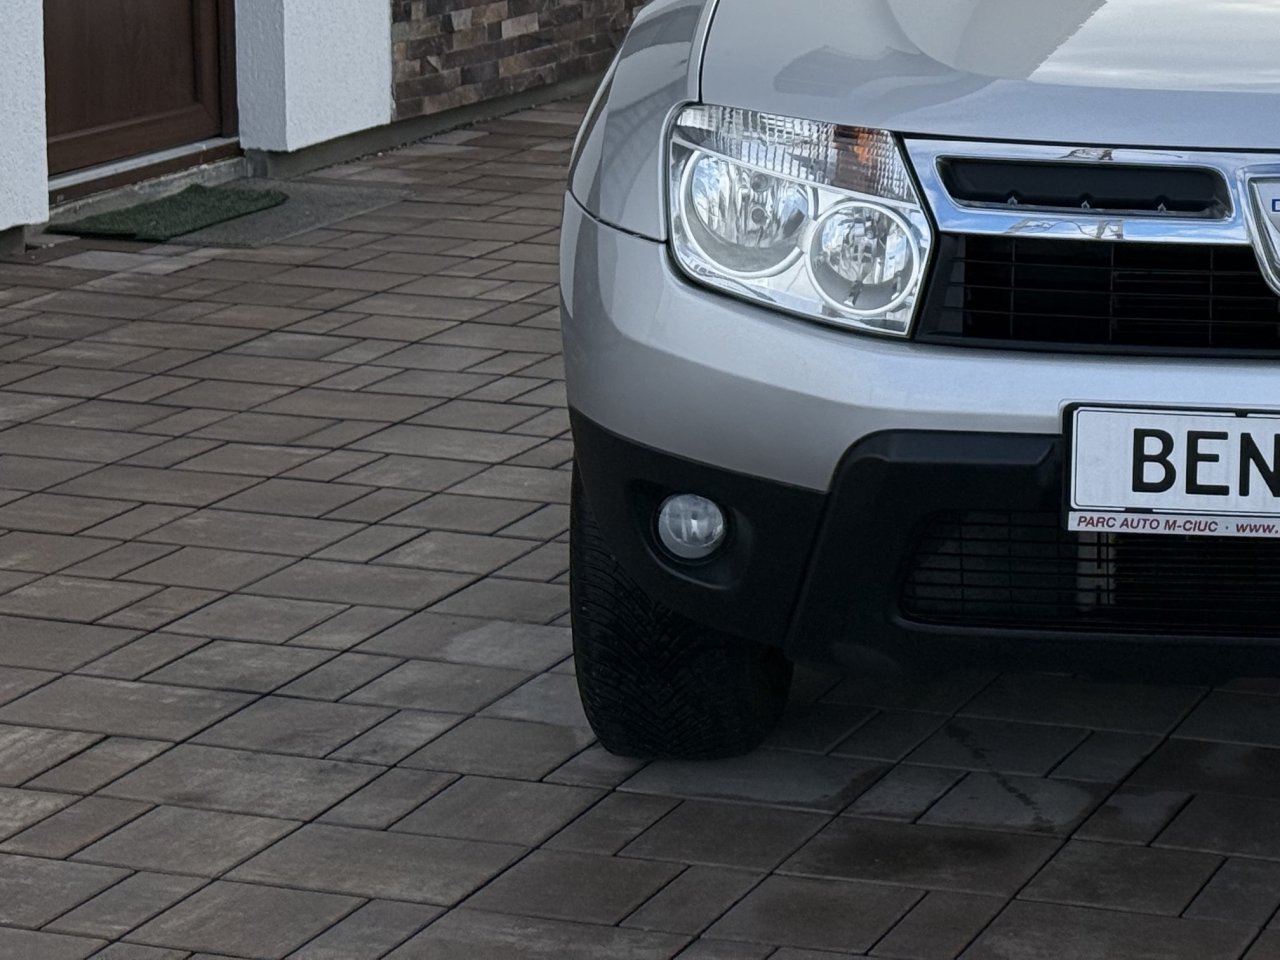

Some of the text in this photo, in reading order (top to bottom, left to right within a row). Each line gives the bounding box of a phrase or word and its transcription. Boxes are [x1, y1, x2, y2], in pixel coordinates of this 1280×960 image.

[1077, 515, 1116, 528] PARC
[1119, 518, 1160, 530] AUTO
[1163, 520, 1218, 533] M-CIUC
